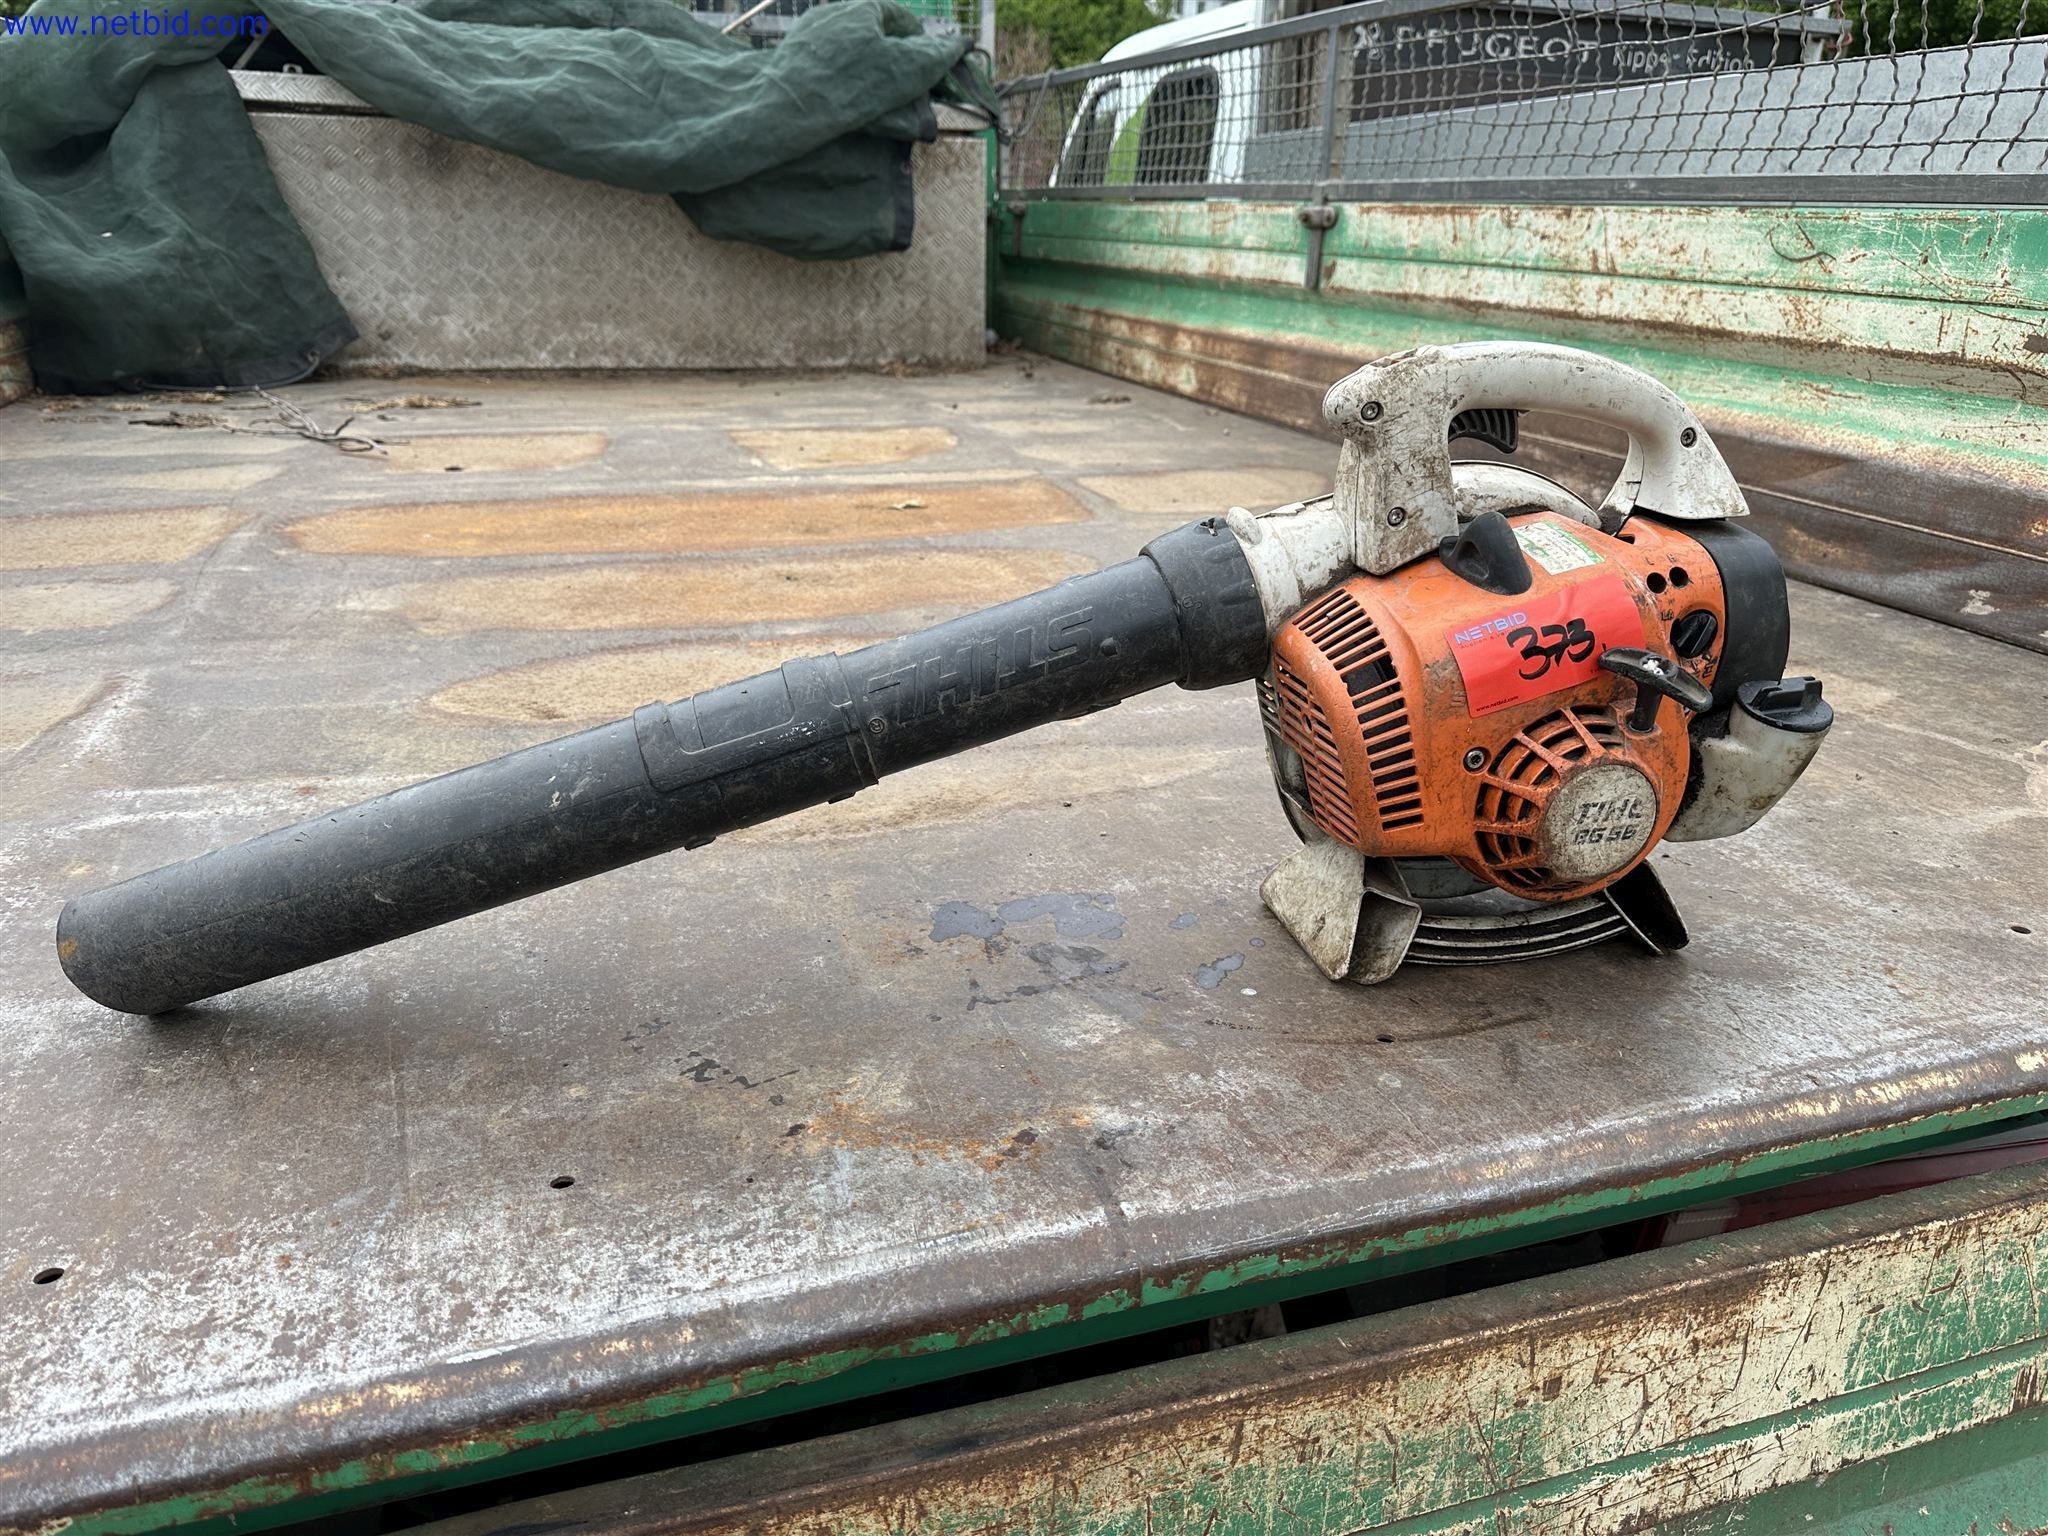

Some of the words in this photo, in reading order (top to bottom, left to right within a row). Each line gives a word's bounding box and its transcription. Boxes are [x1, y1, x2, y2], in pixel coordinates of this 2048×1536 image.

[1454, 611, 1528, 645] NETBID
[1506, 617, 1596, 681] 373
[864, 606, 1093, 726] STIHL
